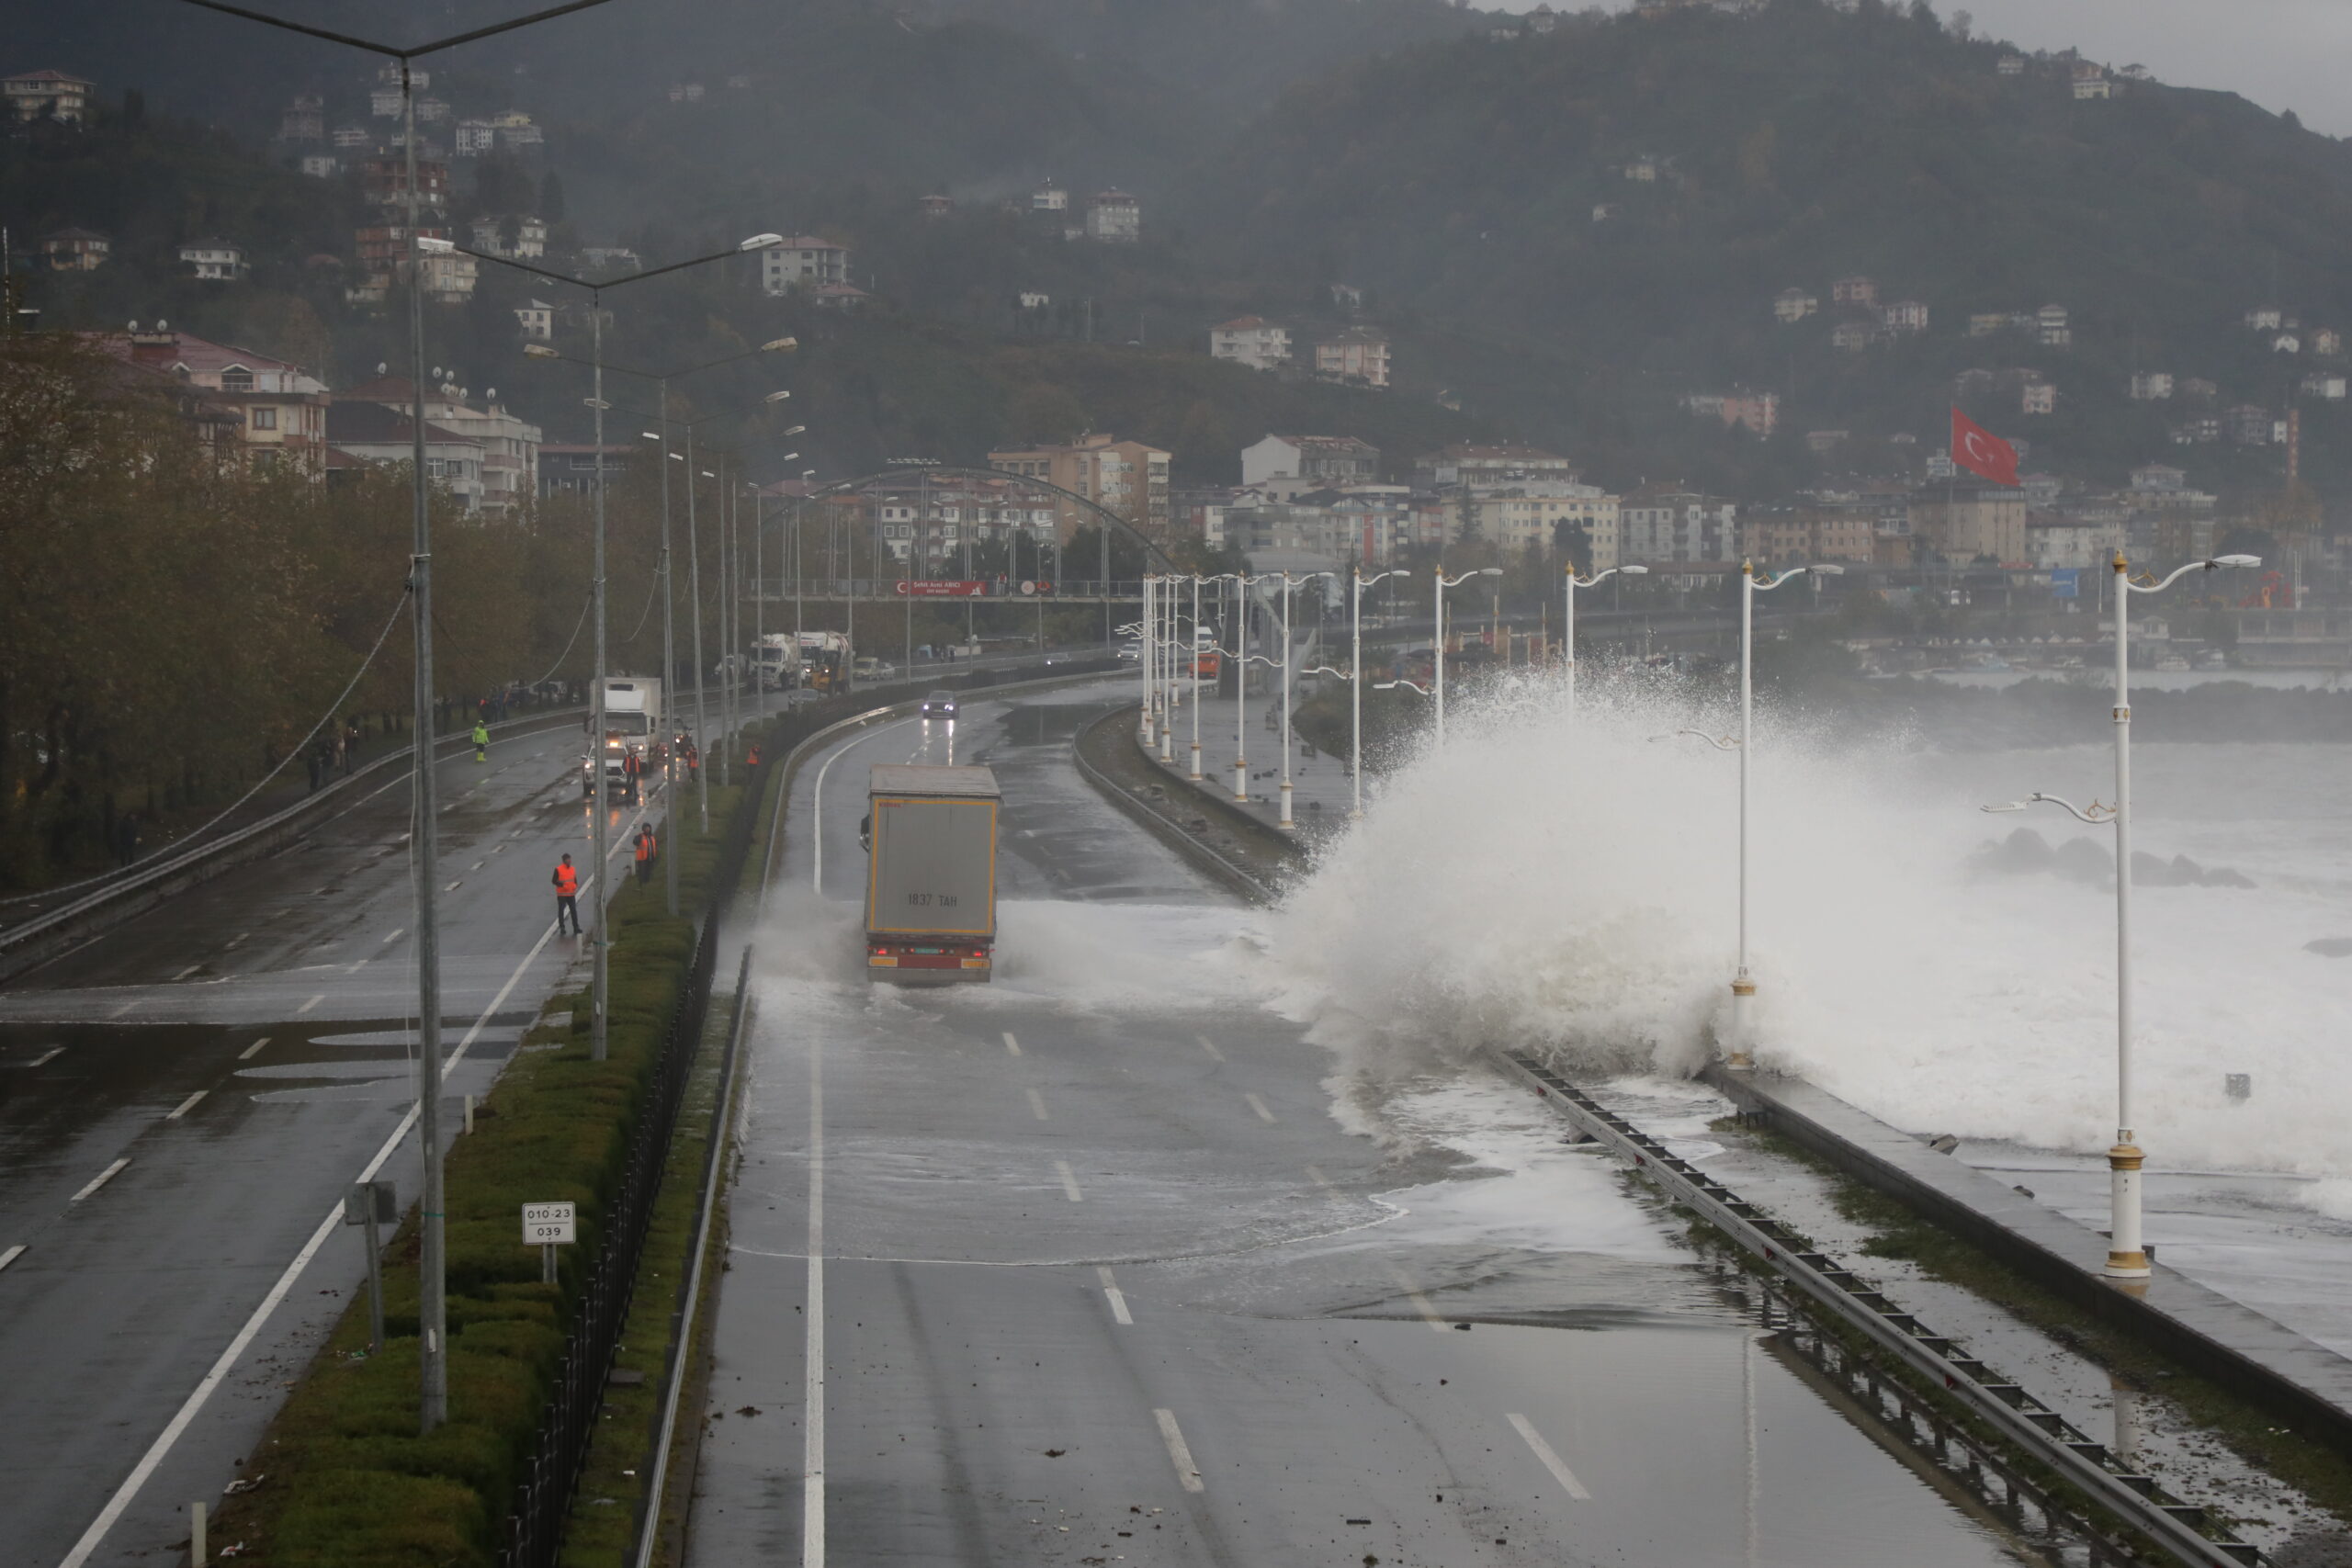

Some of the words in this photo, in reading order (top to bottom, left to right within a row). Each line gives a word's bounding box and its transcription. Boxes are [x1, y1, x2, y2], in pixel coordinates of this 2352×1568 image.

[908, 893, 933, 906] 1837
[938, 895, 957, 907] TAH
[527, 1209, 571, 1219] 010-23
[537, 1227, 560, 1236] 039
